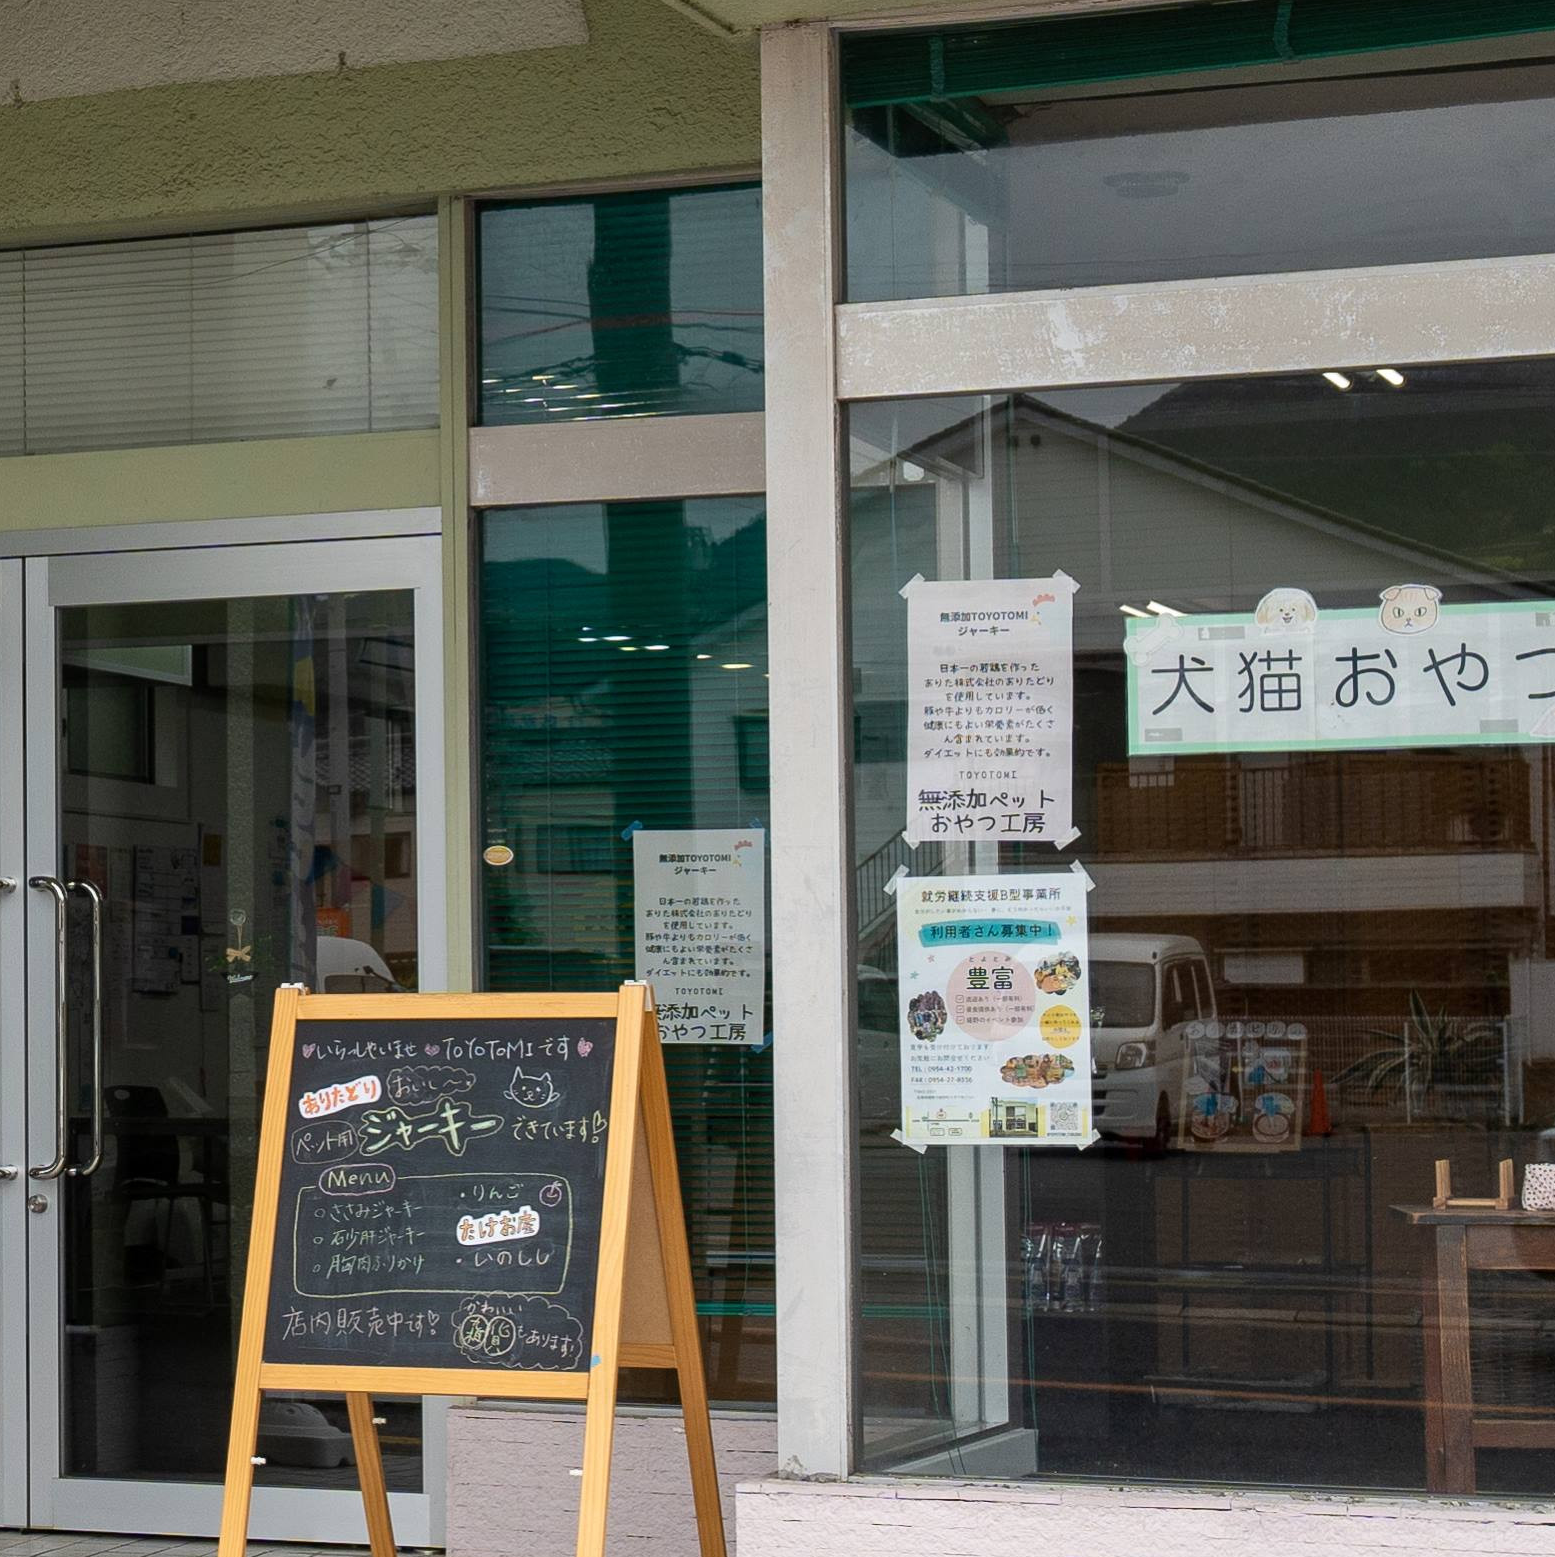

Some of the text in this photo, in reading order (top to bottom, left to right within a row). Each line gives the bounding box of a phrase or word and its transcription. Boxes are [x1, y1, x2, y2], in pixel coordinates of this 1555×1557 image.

[940, 611, 1029, 622] 無添加TOYOTOMI
[958, 625, 1010, 636] ジャーキー
[939, 663, 1040, 675] 日本一の若鶏を作った
[945, 691, 1031, 703] を使用しています。
[944, 733, 1031, 745] ん含まれています。
[924, 747, 1051, 759] ダイエットにも効果的です。
[959, 770, 1018, 779] TOYOTOMI
[918, 788, 1055, 811] 無添加ペット
[931, 812, 1046, 834] おやつ工房
[659, 854, 732, 864] 無添加TOYOTOMI
[673, 866, 717, 876] ジャーキー
[662, 920, 734, 930] を使用しています。
[662, 956, 735, 966] ん含まれています。
[966, 966, 1014, 990] 豊富
[675, 987, 724, 996] TOYOTOMI
[316, 1039, 418, 1061] いらっしゃいませ
[301, 1079, 378, 1115] ありたどり
[367, 1101, 497, 1152] ジャーキー
[295, 1130, 354, 1155] ペット用
[327, 1170, 390, 1189] Menu
[472, 1183, 524, 1202] りんご
[329, 1200, 422, 1224] ささみジャーキー
[459, 1209, 538, 1242] たけお産
[330, 1227, 426, 1252] 砂肝ジャーキー
[326, 1254, 426, 1280] 胸肉ふりかけ
[475, 1249, 550, 1267] いのしし
